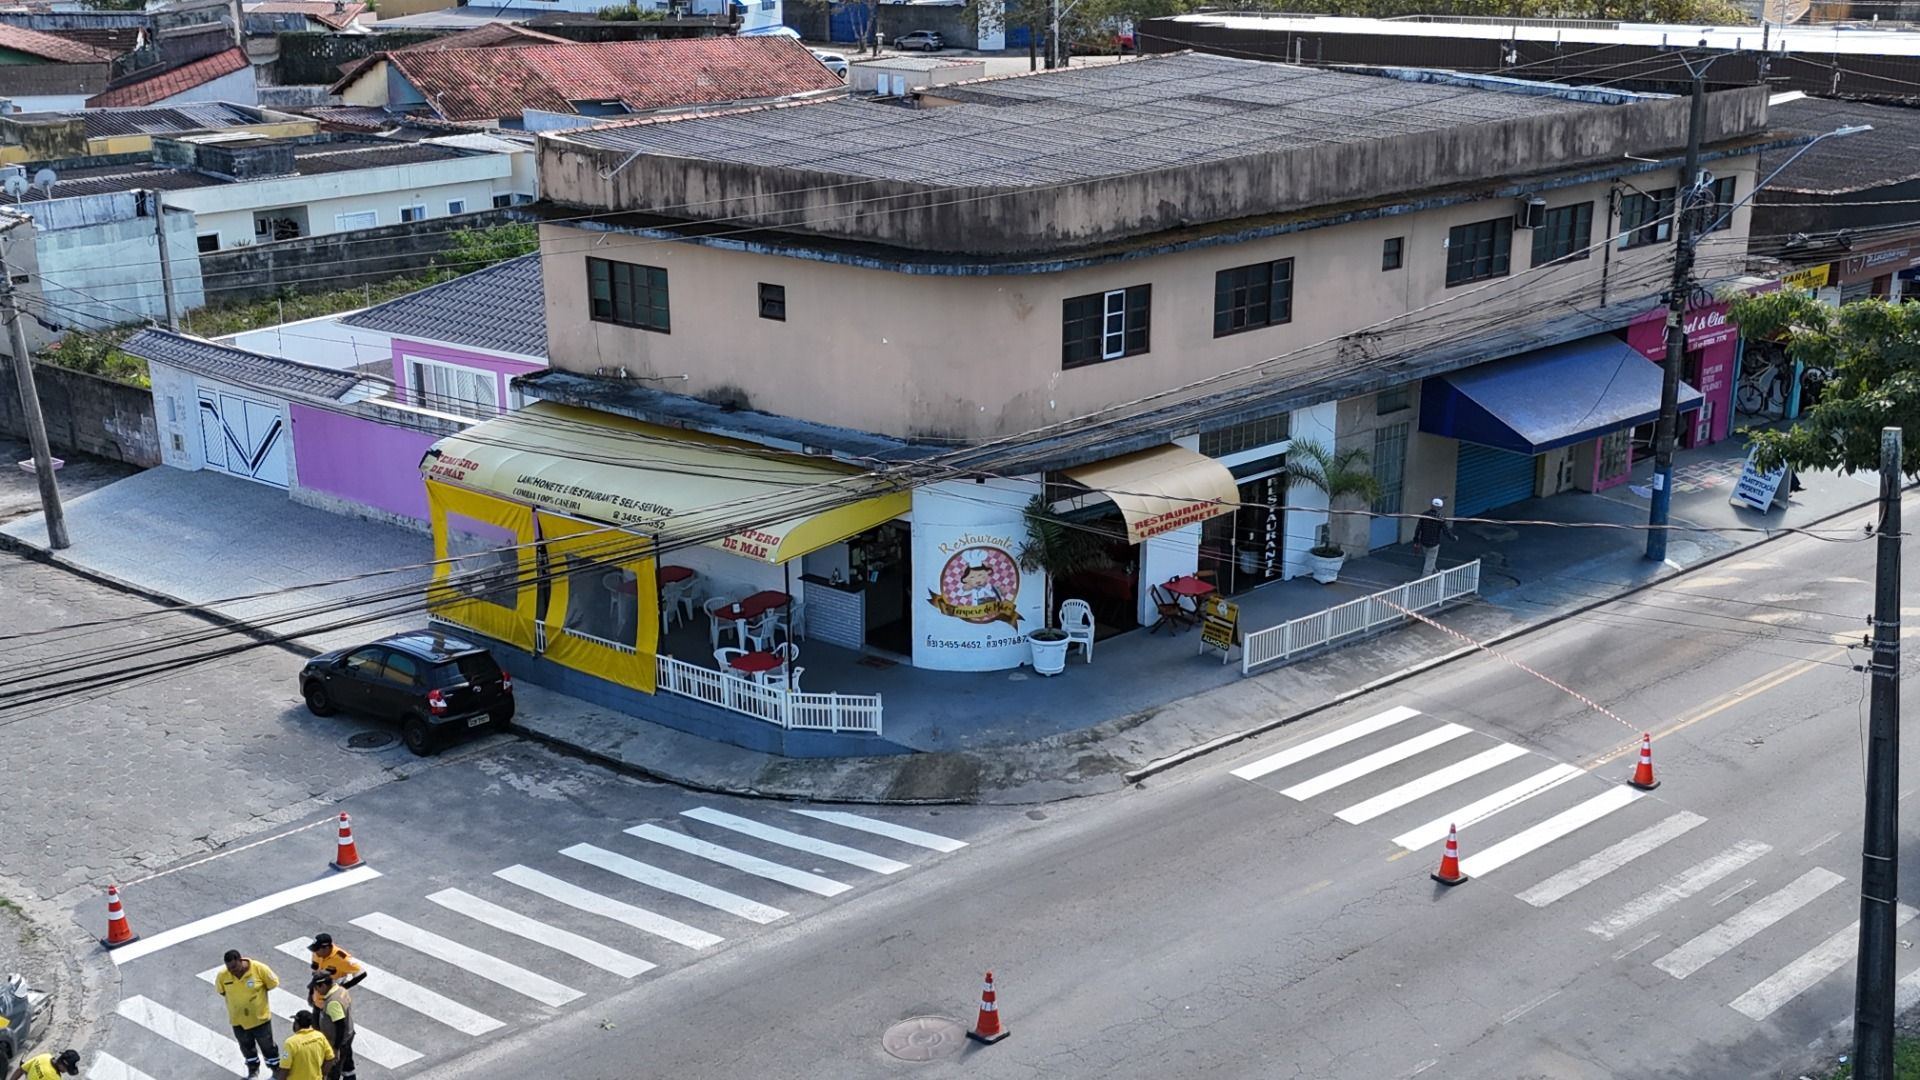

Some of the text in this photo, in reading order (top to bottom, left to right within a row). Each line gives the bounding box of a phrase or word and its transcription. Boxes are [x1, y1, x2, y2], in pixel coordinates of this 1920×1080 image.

[1699, 316, 1706, 330] &
[1707, 312, 1727, 328] Cia
[430, 465, 442, 474] DE
[537, 493, 554, 504] 100%
[554, 497, 582, 510] CASEIRA
[568, 486, 620, 505] RESTAURANTE
[619, 498, 674, 518] SELF-SERVICE
[1134, 496, 1222, 530] RESTAURANTE
[1139, 507, 1220, 538] LANCHONETE
[1265, 477, 1279, 578] RESTAURANTE
[724, 537, 738, 549] DE
[938, 533, 1014, 555] Restaurante
[938, 639, 982, 649] 3455-4652
